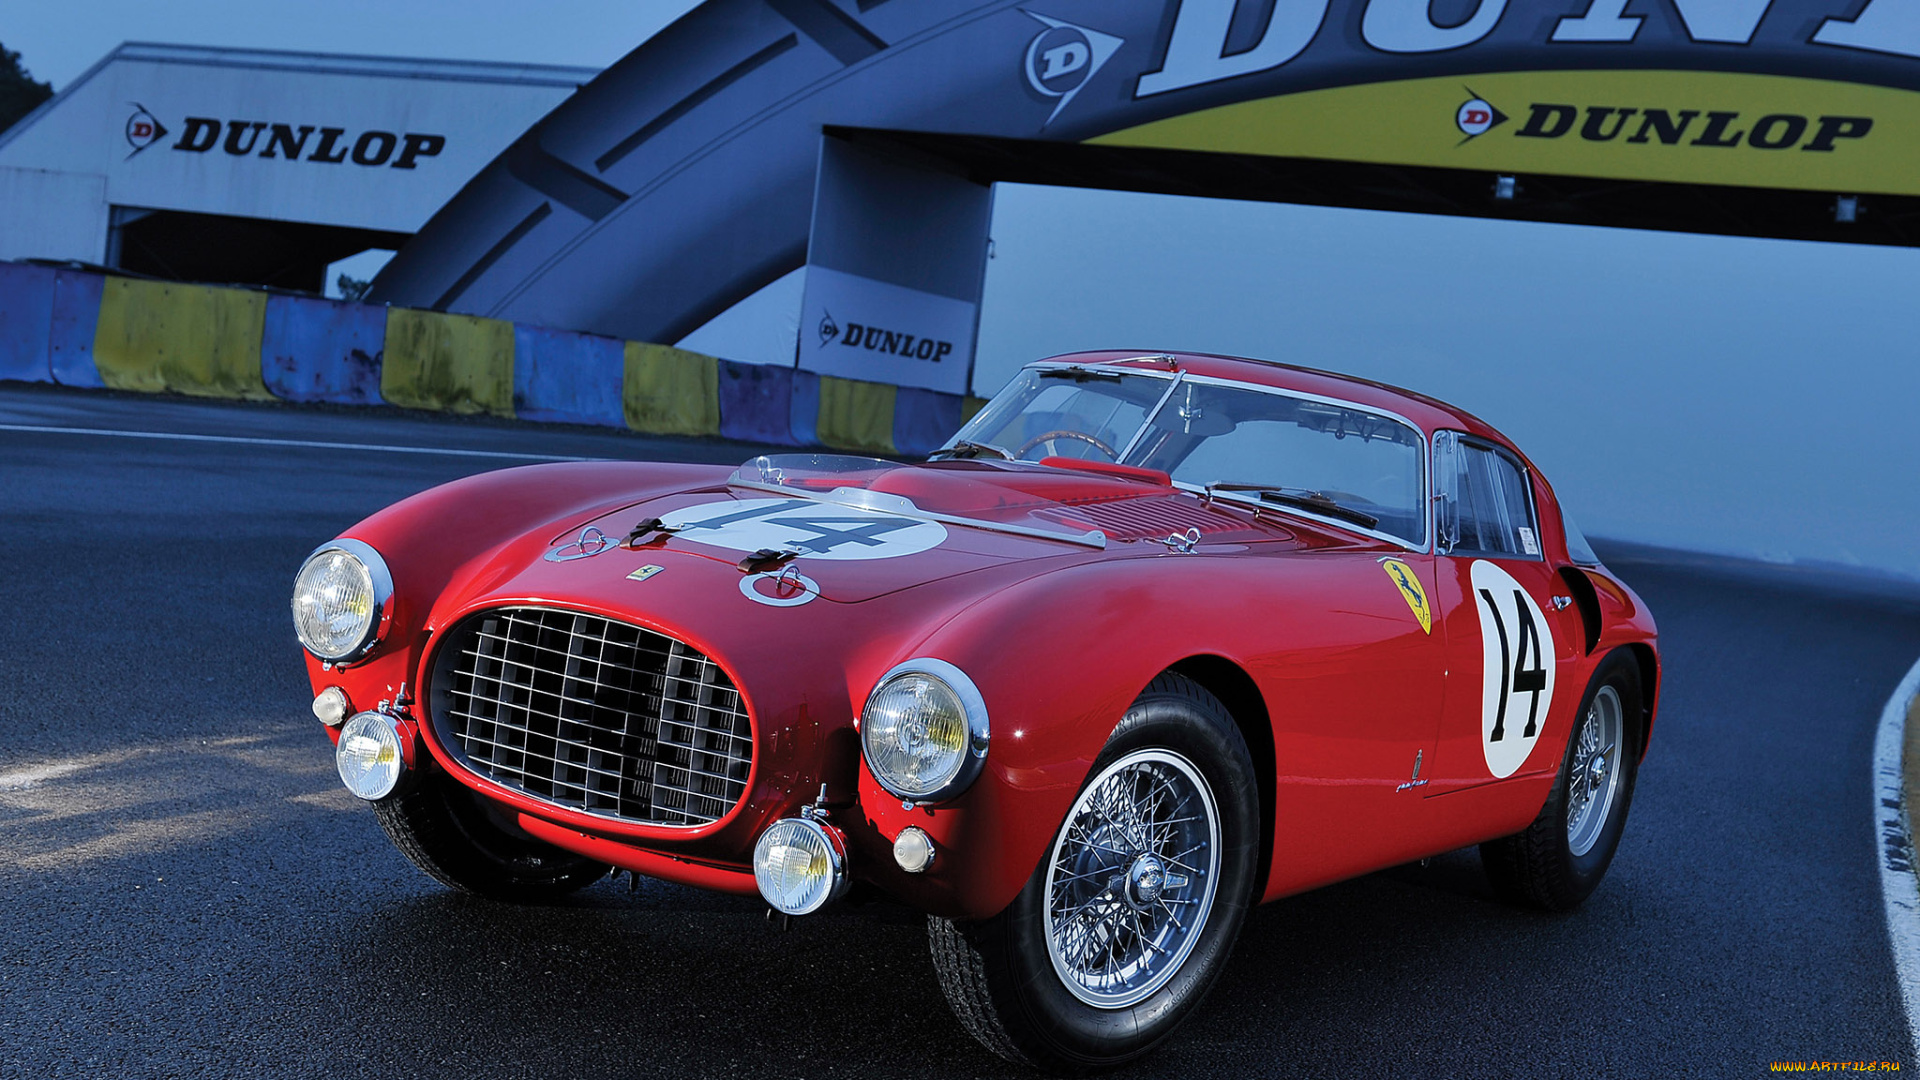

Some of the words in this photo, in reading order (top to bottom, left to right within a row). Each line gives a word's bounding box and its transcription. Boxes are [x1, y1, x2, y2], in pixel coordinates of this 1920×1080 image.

[1042, 41, 1089, 80] D
[131, 122, 153, 138] D
[172, 116, 446, 169] DUNLOP
[1462, 110, 1490, 125] D
[1514, 103, 1874, 152] DUNLOP
[841, 323, 953, 362] DUNLOP
[681, 499, 927, 553] 14
[1478, 588, 1547, 743] 14
